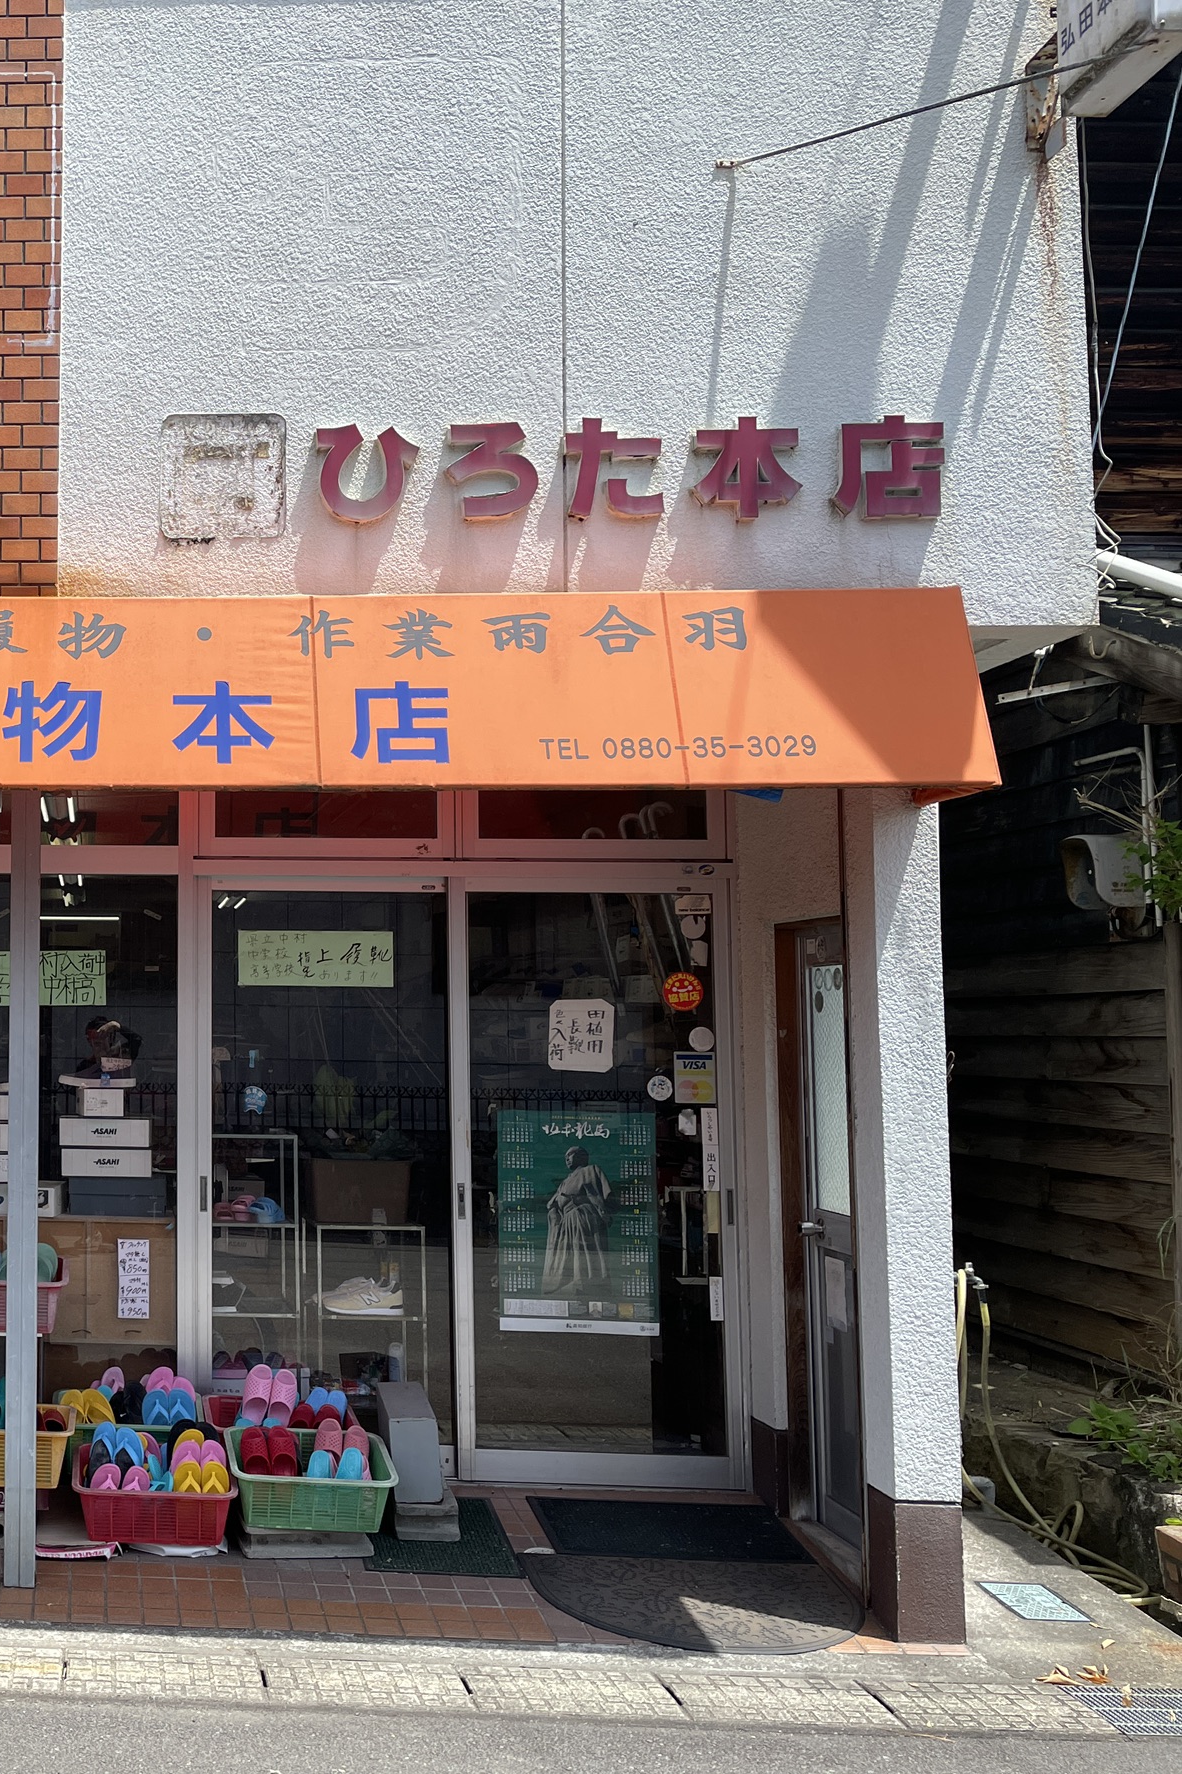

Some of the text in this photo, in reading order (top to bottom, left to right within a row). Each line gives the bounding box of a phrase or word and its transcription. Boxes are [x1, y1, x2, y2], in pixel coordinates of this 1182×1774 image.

[315, 415, 945, 523] ひろた本店
[539, 735, 817, 760] TEL 0880-35-3029
[682, 1061, 707, 1070] VISA
[90, 1128, 118, 1136] ASAHI
[93, 1158, 120, 1166] ASAHI
[706, 1152, 716, 1183] 出入口
